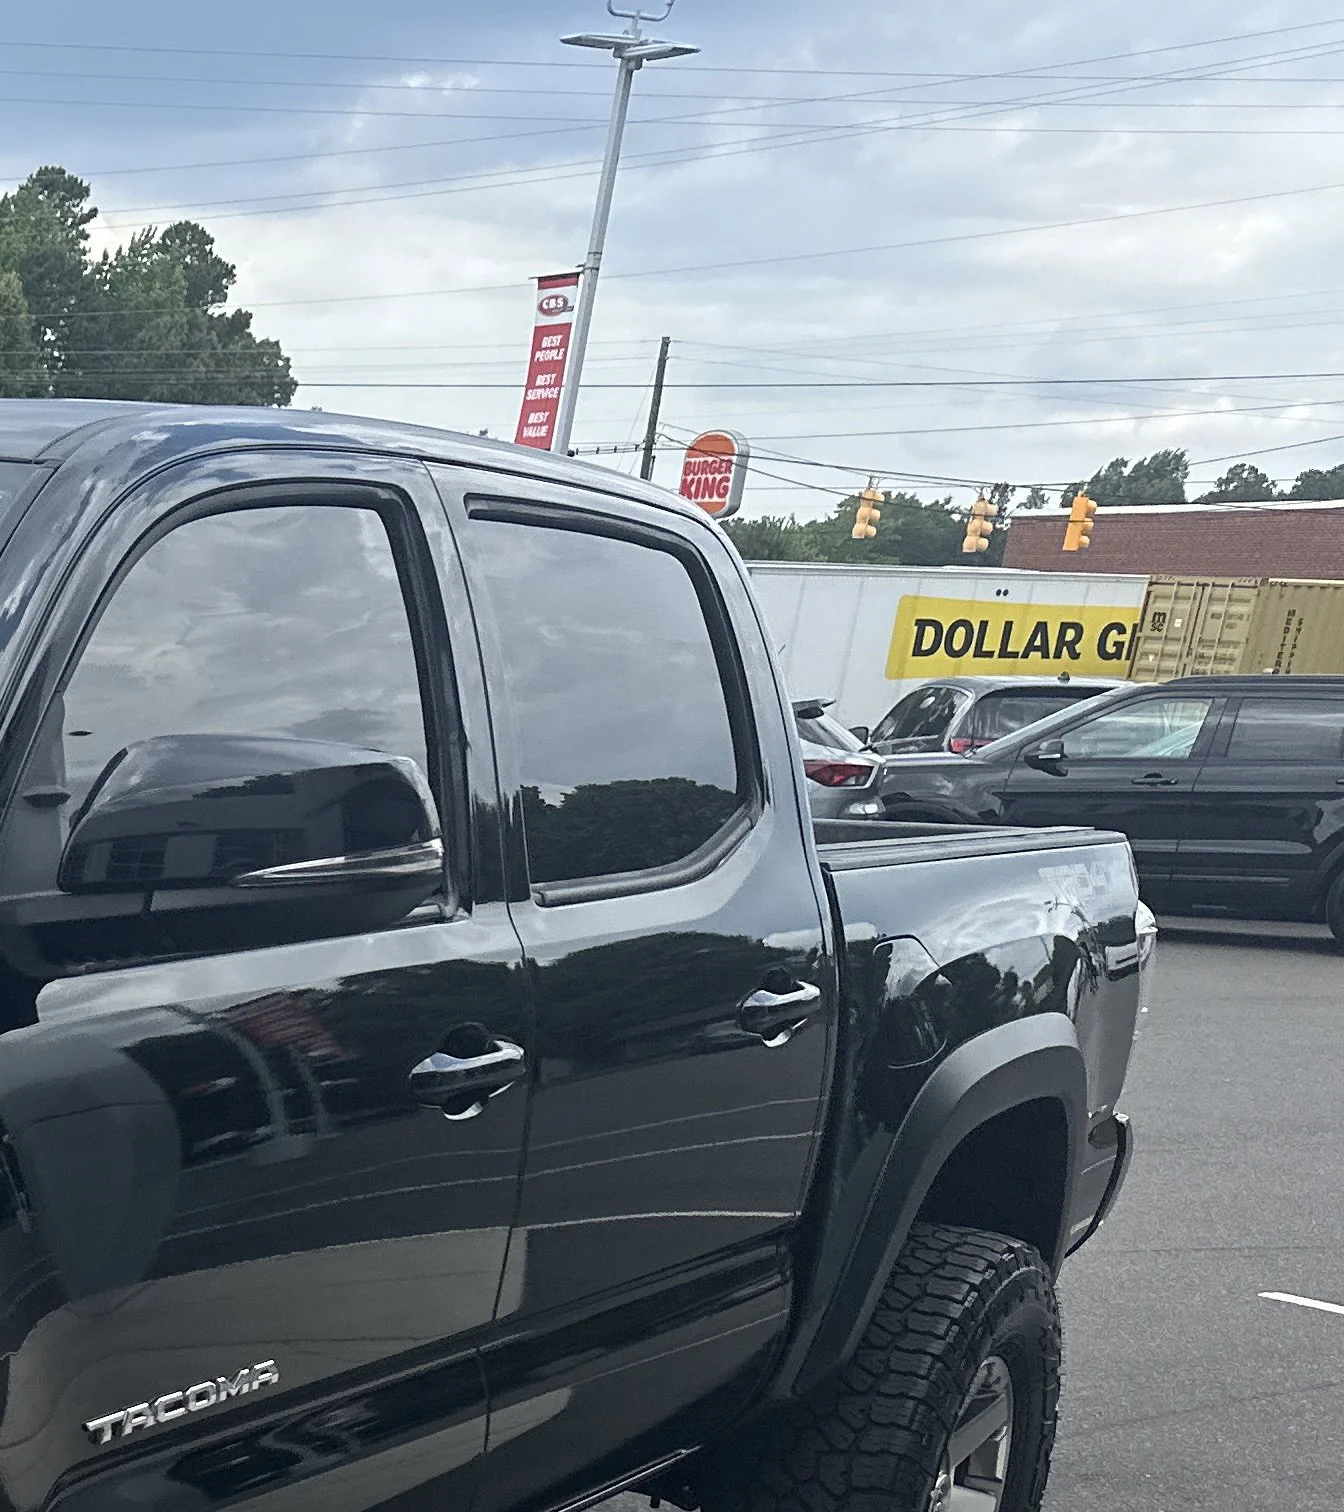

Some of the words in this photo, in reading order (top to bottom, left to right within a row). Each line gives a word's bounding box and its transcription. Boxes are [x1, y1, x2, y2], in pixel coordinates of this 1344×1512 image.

[542, 297, 564, 309] CBS
[541, 335, 563, 348] BEST
[534, 348, 565, 362] PEOPLE
[535, 373, 557, 386] BEST
[526, 387, 560, 400] SERVICE
[527, 412, 549, 424] BEST
[522, 425, 549, 438] VALUE
[683, 459, 733, 476] BURGER
[679, 476, 730, 500] KING
[912, 618, 1084, 660] DOLLAR
[82, 1358, 281, 1445] TACOMA
